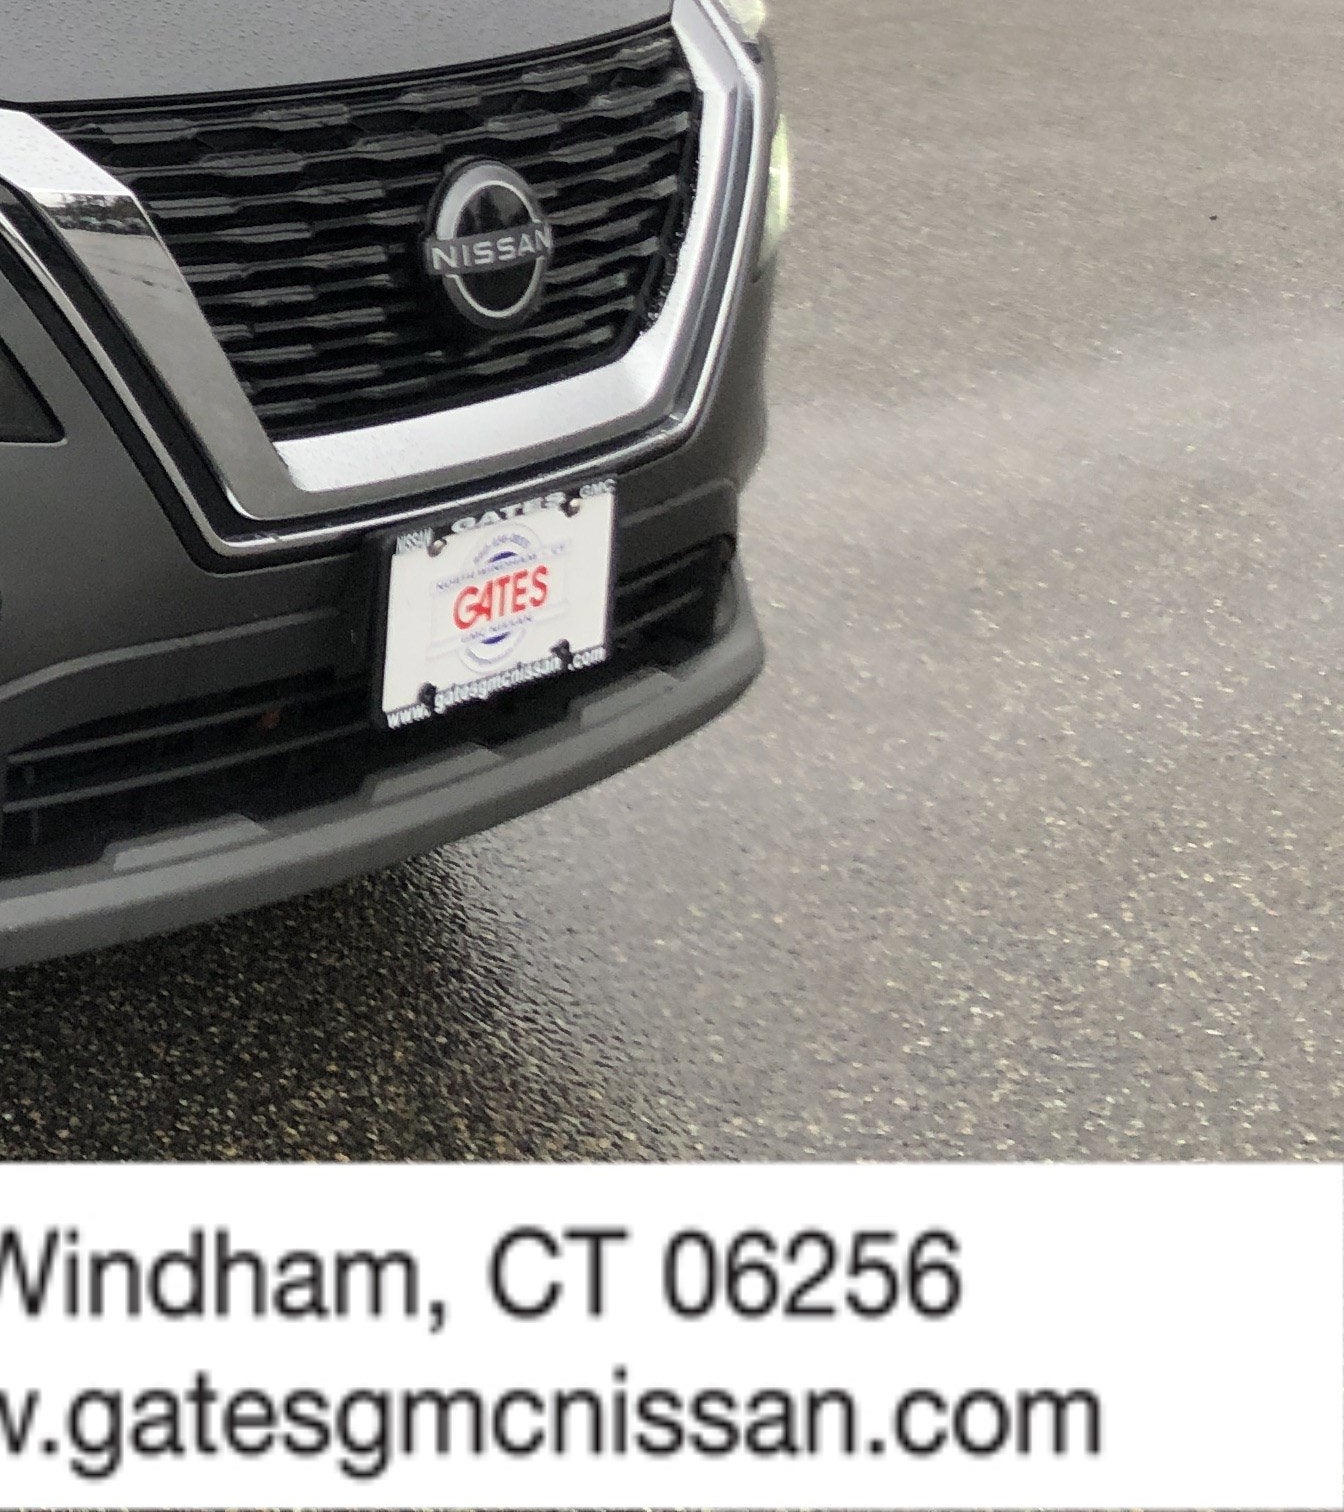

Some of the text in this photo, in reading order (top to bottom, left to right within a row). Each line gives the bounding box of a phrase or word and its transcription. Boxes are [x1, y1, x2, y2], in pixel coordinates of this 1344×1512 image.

[430, 225, 554, 271] NISSAN
[451, 491, 567, 534] GATES
[453, 564, 549, 629] GATES
